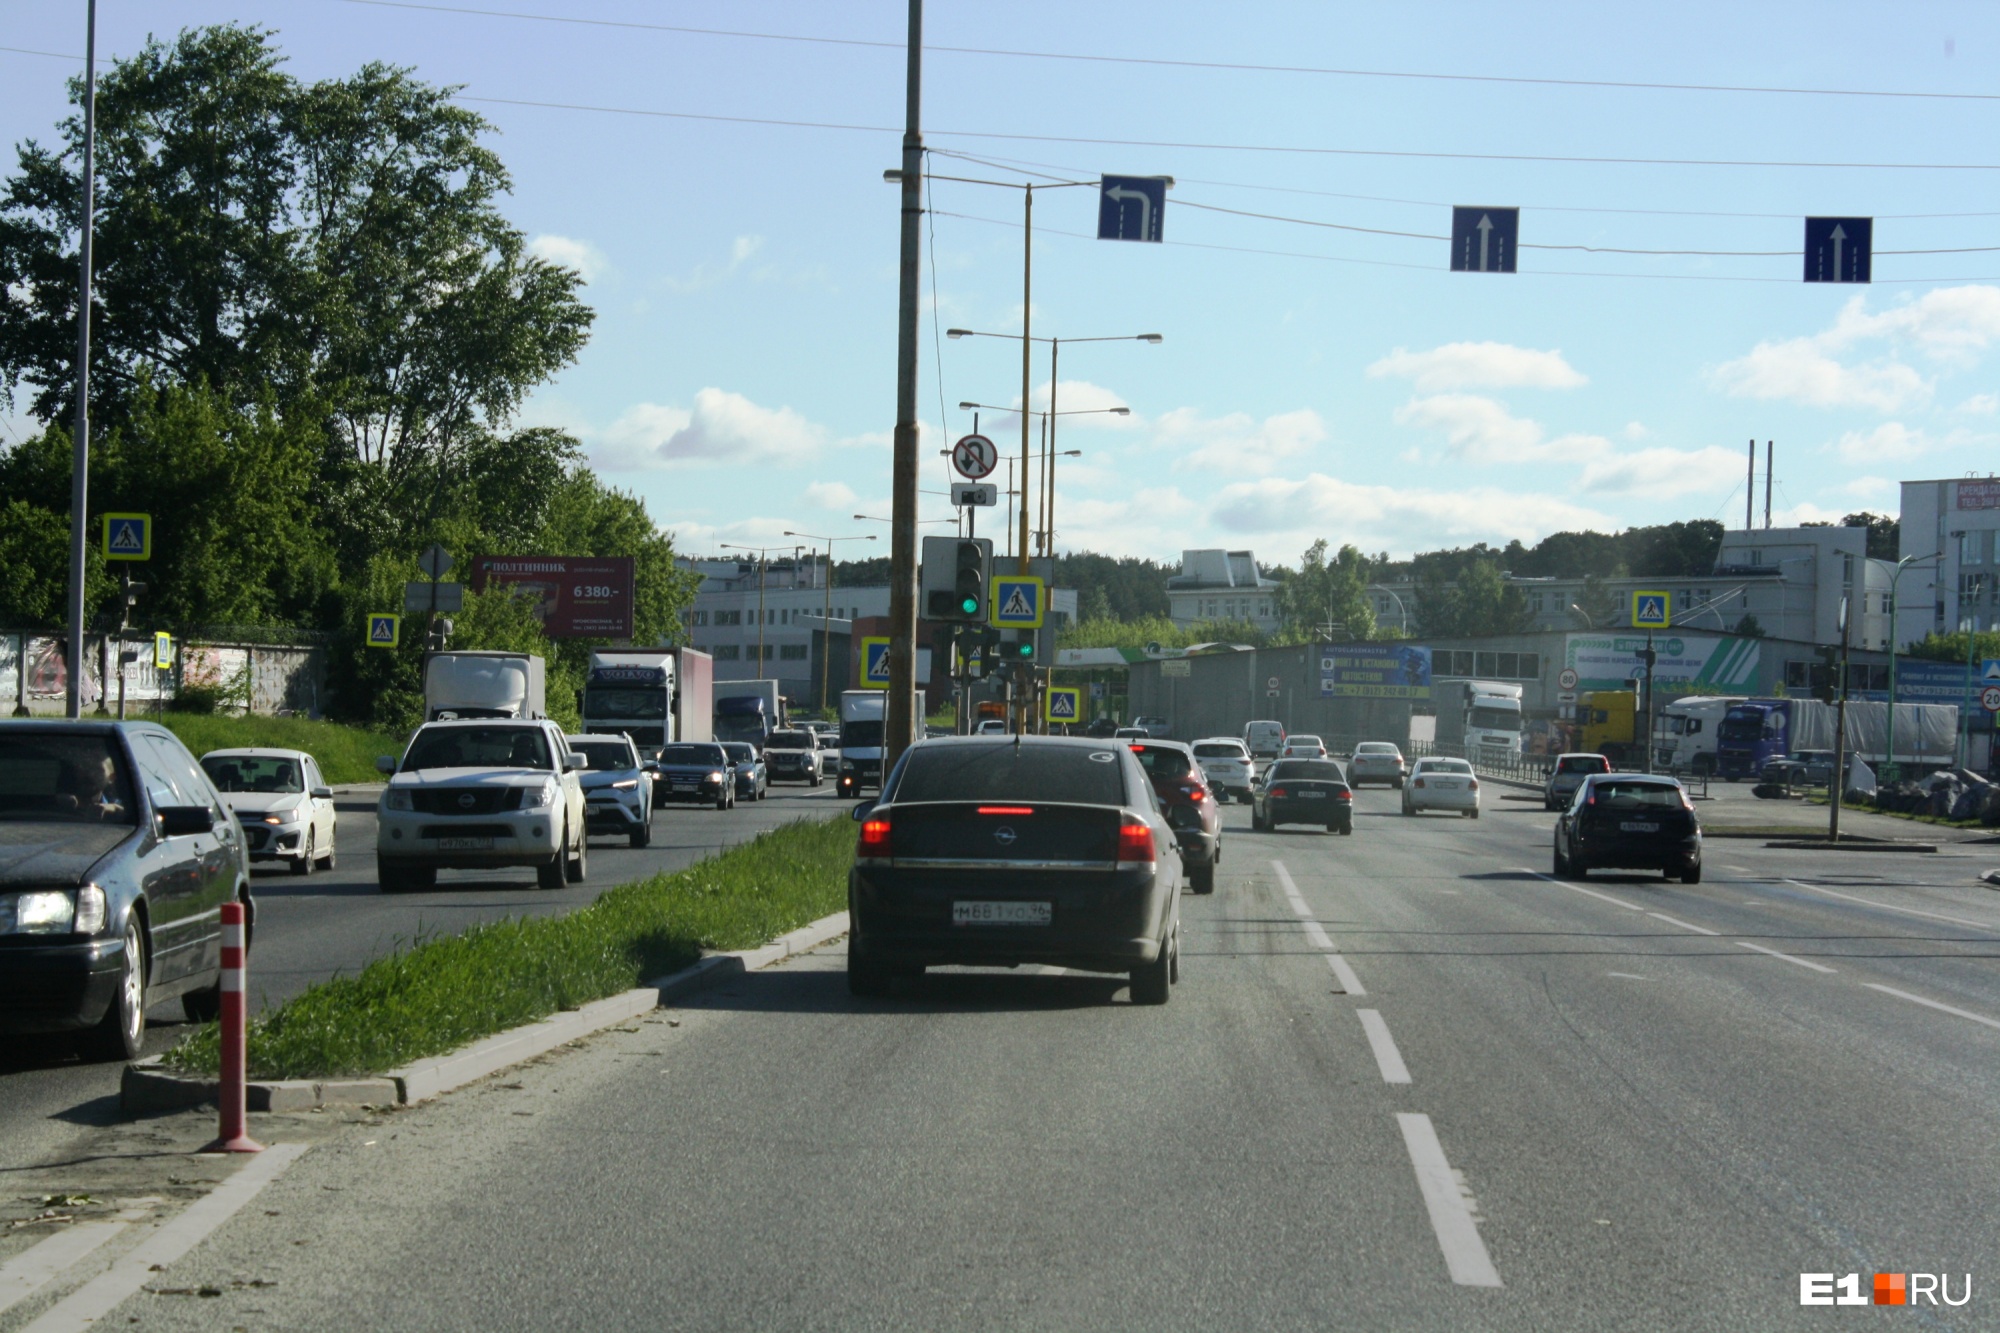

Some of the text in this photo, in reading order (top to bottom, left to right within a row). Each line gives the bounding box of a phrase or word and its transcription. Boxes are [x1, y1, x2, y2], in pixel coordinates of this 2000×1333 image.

[1959, 485, 1988, 496] АРЕНДА
[493, 562, 566, 573] ПОЛТИННИК
[600, 669, 654, 679] VOLVO
[1563, 676, 1574, 684] 80
[1985, 694, 2000, 704] 20
